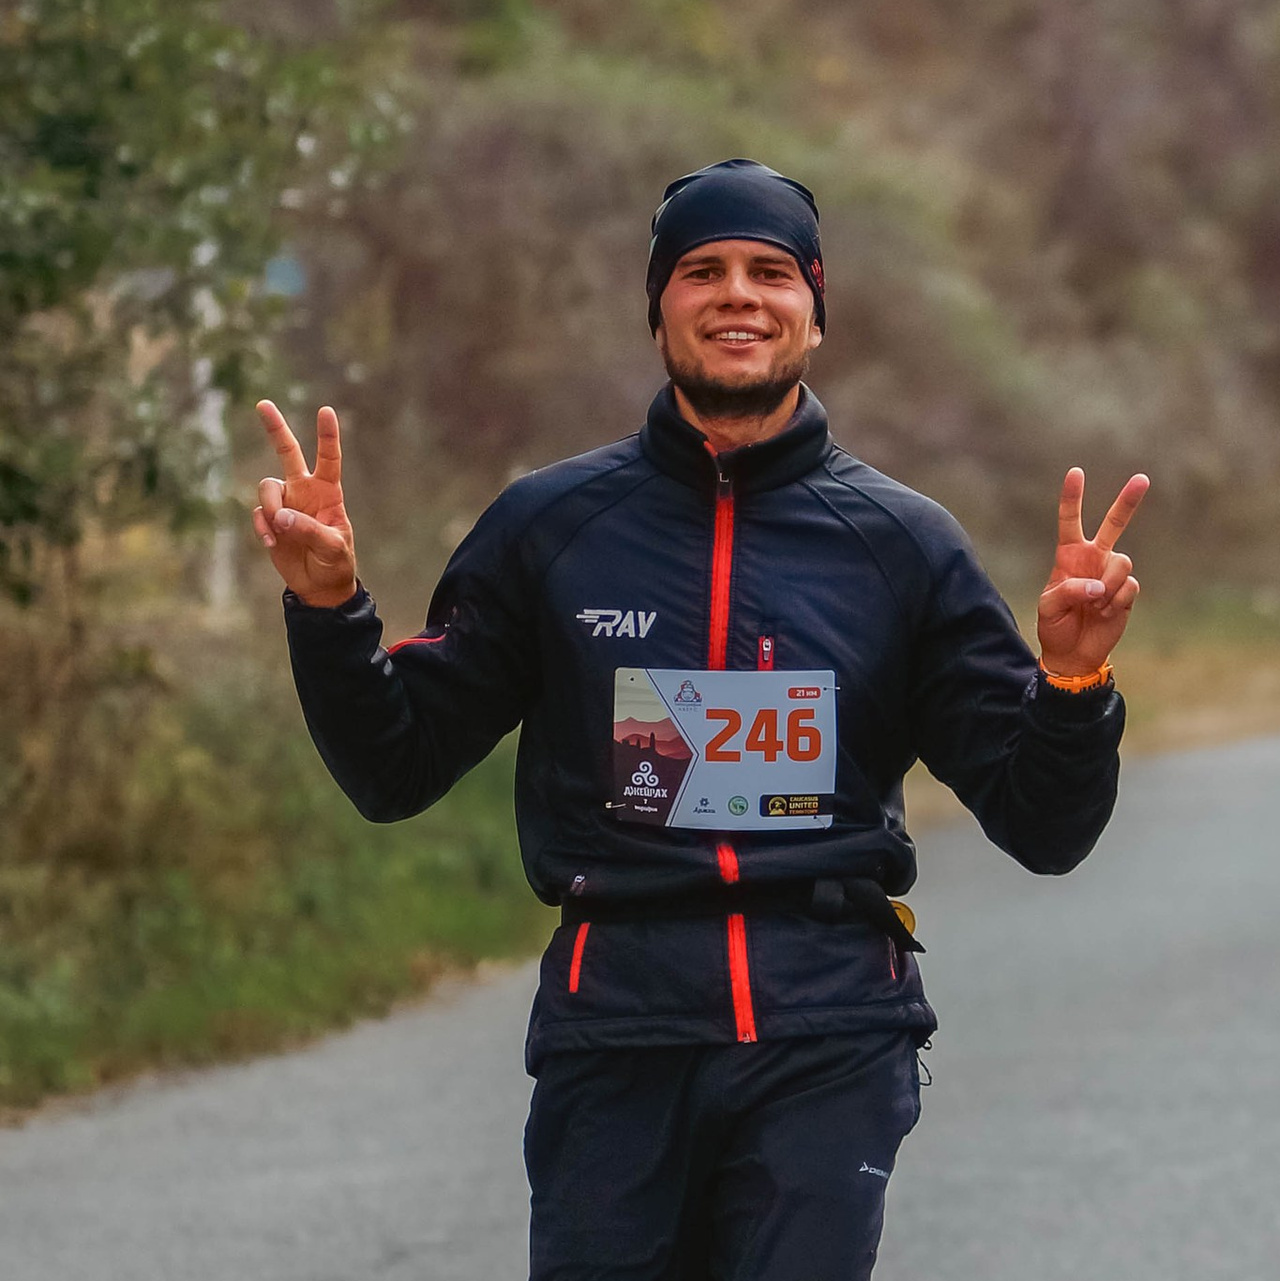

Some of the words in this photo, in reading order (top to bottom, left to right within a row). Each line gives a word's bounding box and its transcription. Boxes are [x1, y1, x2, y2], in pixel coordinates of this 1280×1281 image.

[796, 689, 805, 697] 21
[705, 708, 822, 762] 246
[623, 786, 668, 798] ДЖЕЙРАХ
[789, 801, 819, 809] UNITED
